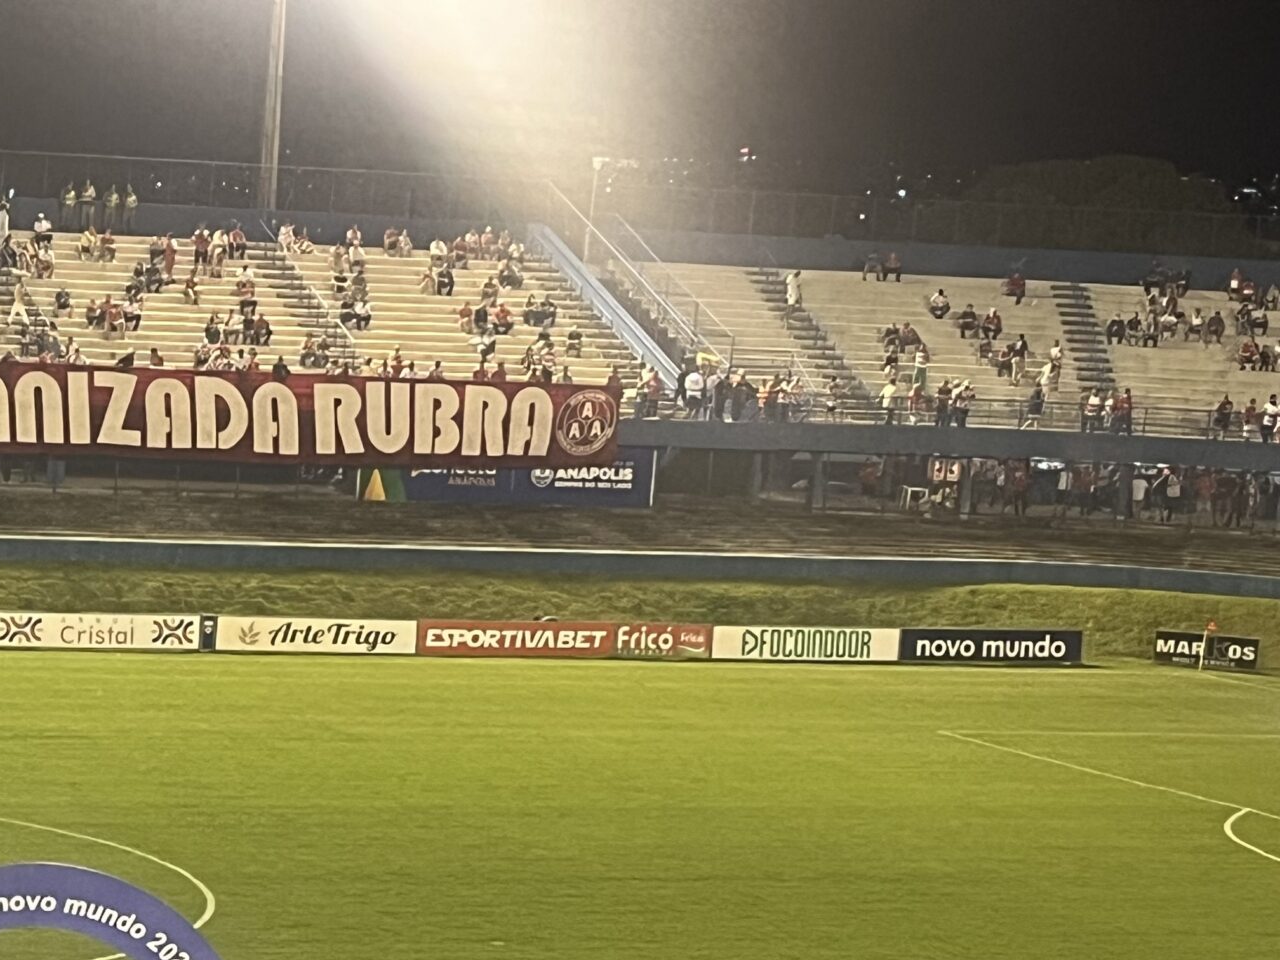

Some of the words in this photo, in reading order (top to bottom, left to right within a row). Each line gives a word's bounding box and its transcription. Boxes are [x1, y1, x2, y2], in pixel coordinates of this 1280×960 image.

[314, 381, 554, 457] RUBRA
[60, 625, 134, 645] Cristal
[425, 628, 607, 649] ESPORTIVABET
[916, 638, 976, 657] novo
[982, 634, 1066, 659] mundo
[62, 898, 148, 940] mundo
